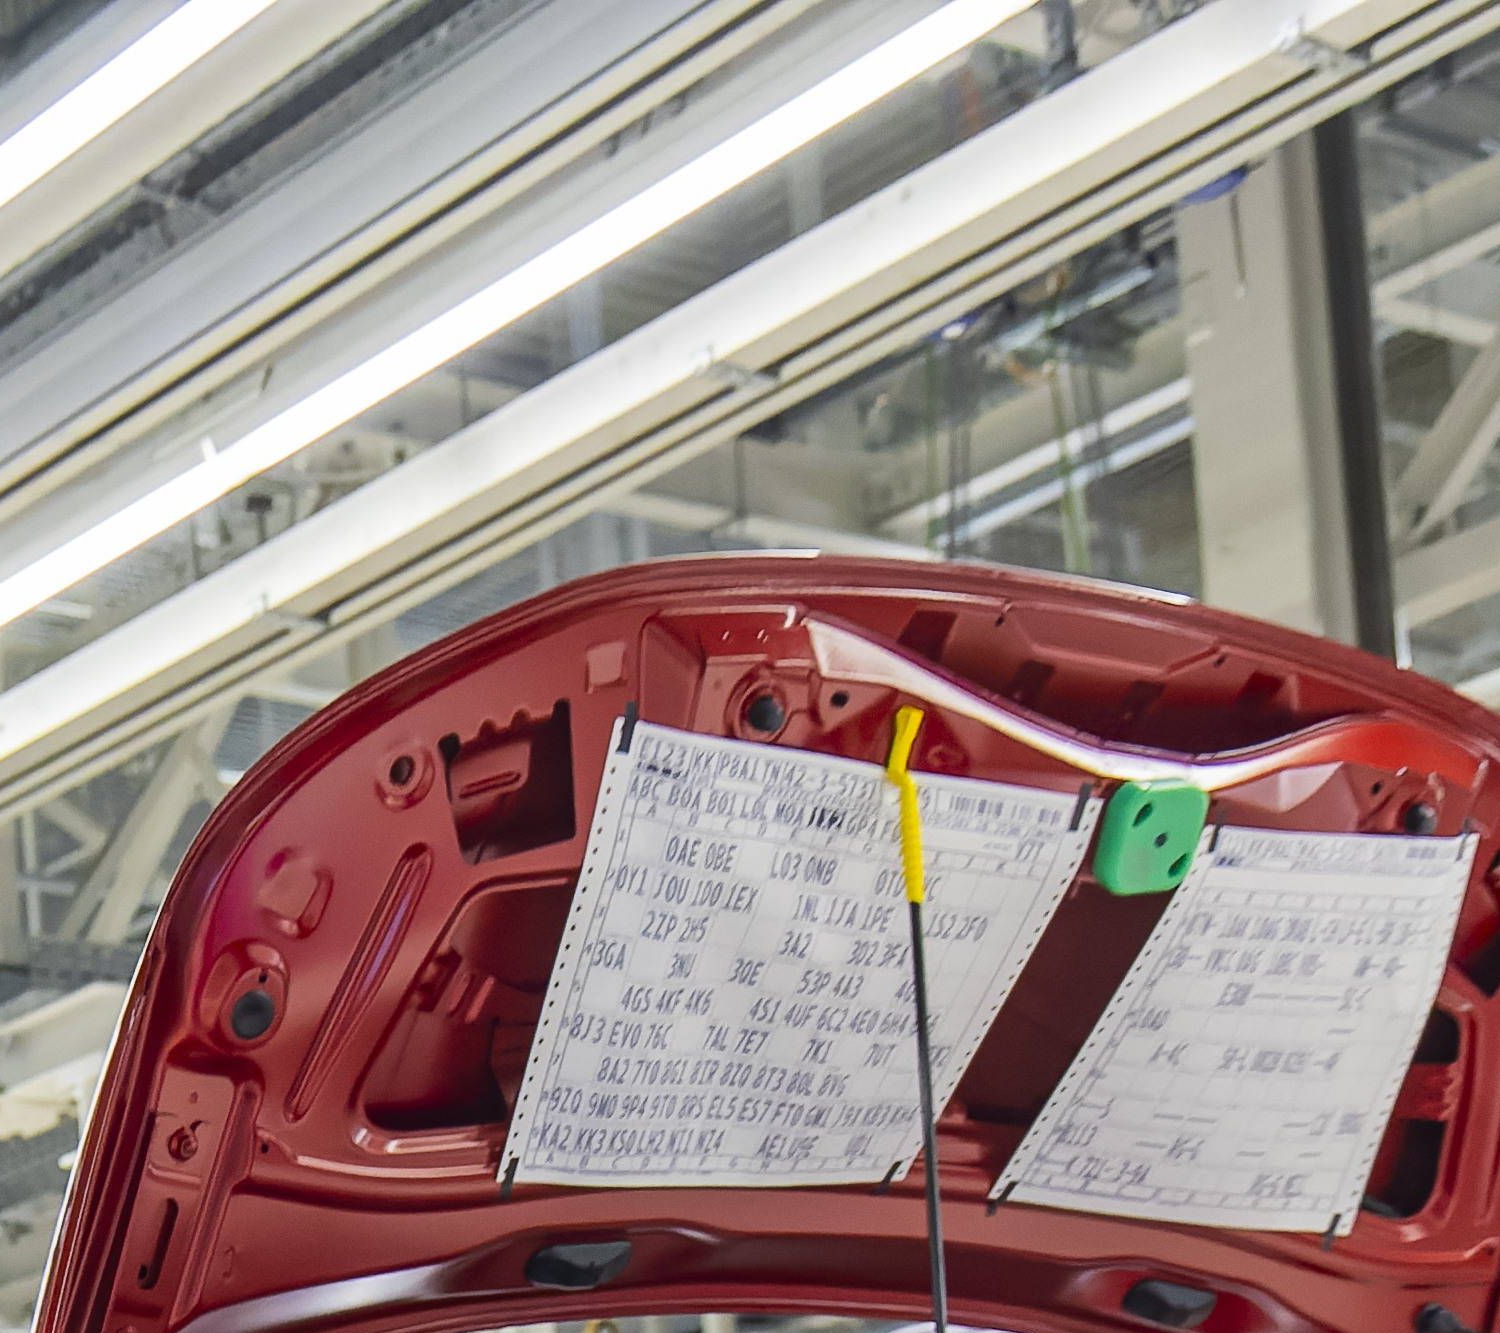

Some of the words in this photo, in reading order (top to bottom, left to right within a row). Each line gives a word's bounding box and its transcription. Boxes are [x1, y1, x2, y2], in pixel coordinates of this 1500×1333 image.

[666, 836, 700, 866] 0AE
[705, 843, 735, 871] 0BE
[780, 931, 810, 957] 3A2
[568, 1013, 605, 1042] 8J3
[735, 1029, 768, 1053] 7E7
[598, 1057, 628, 1083] 8A2
